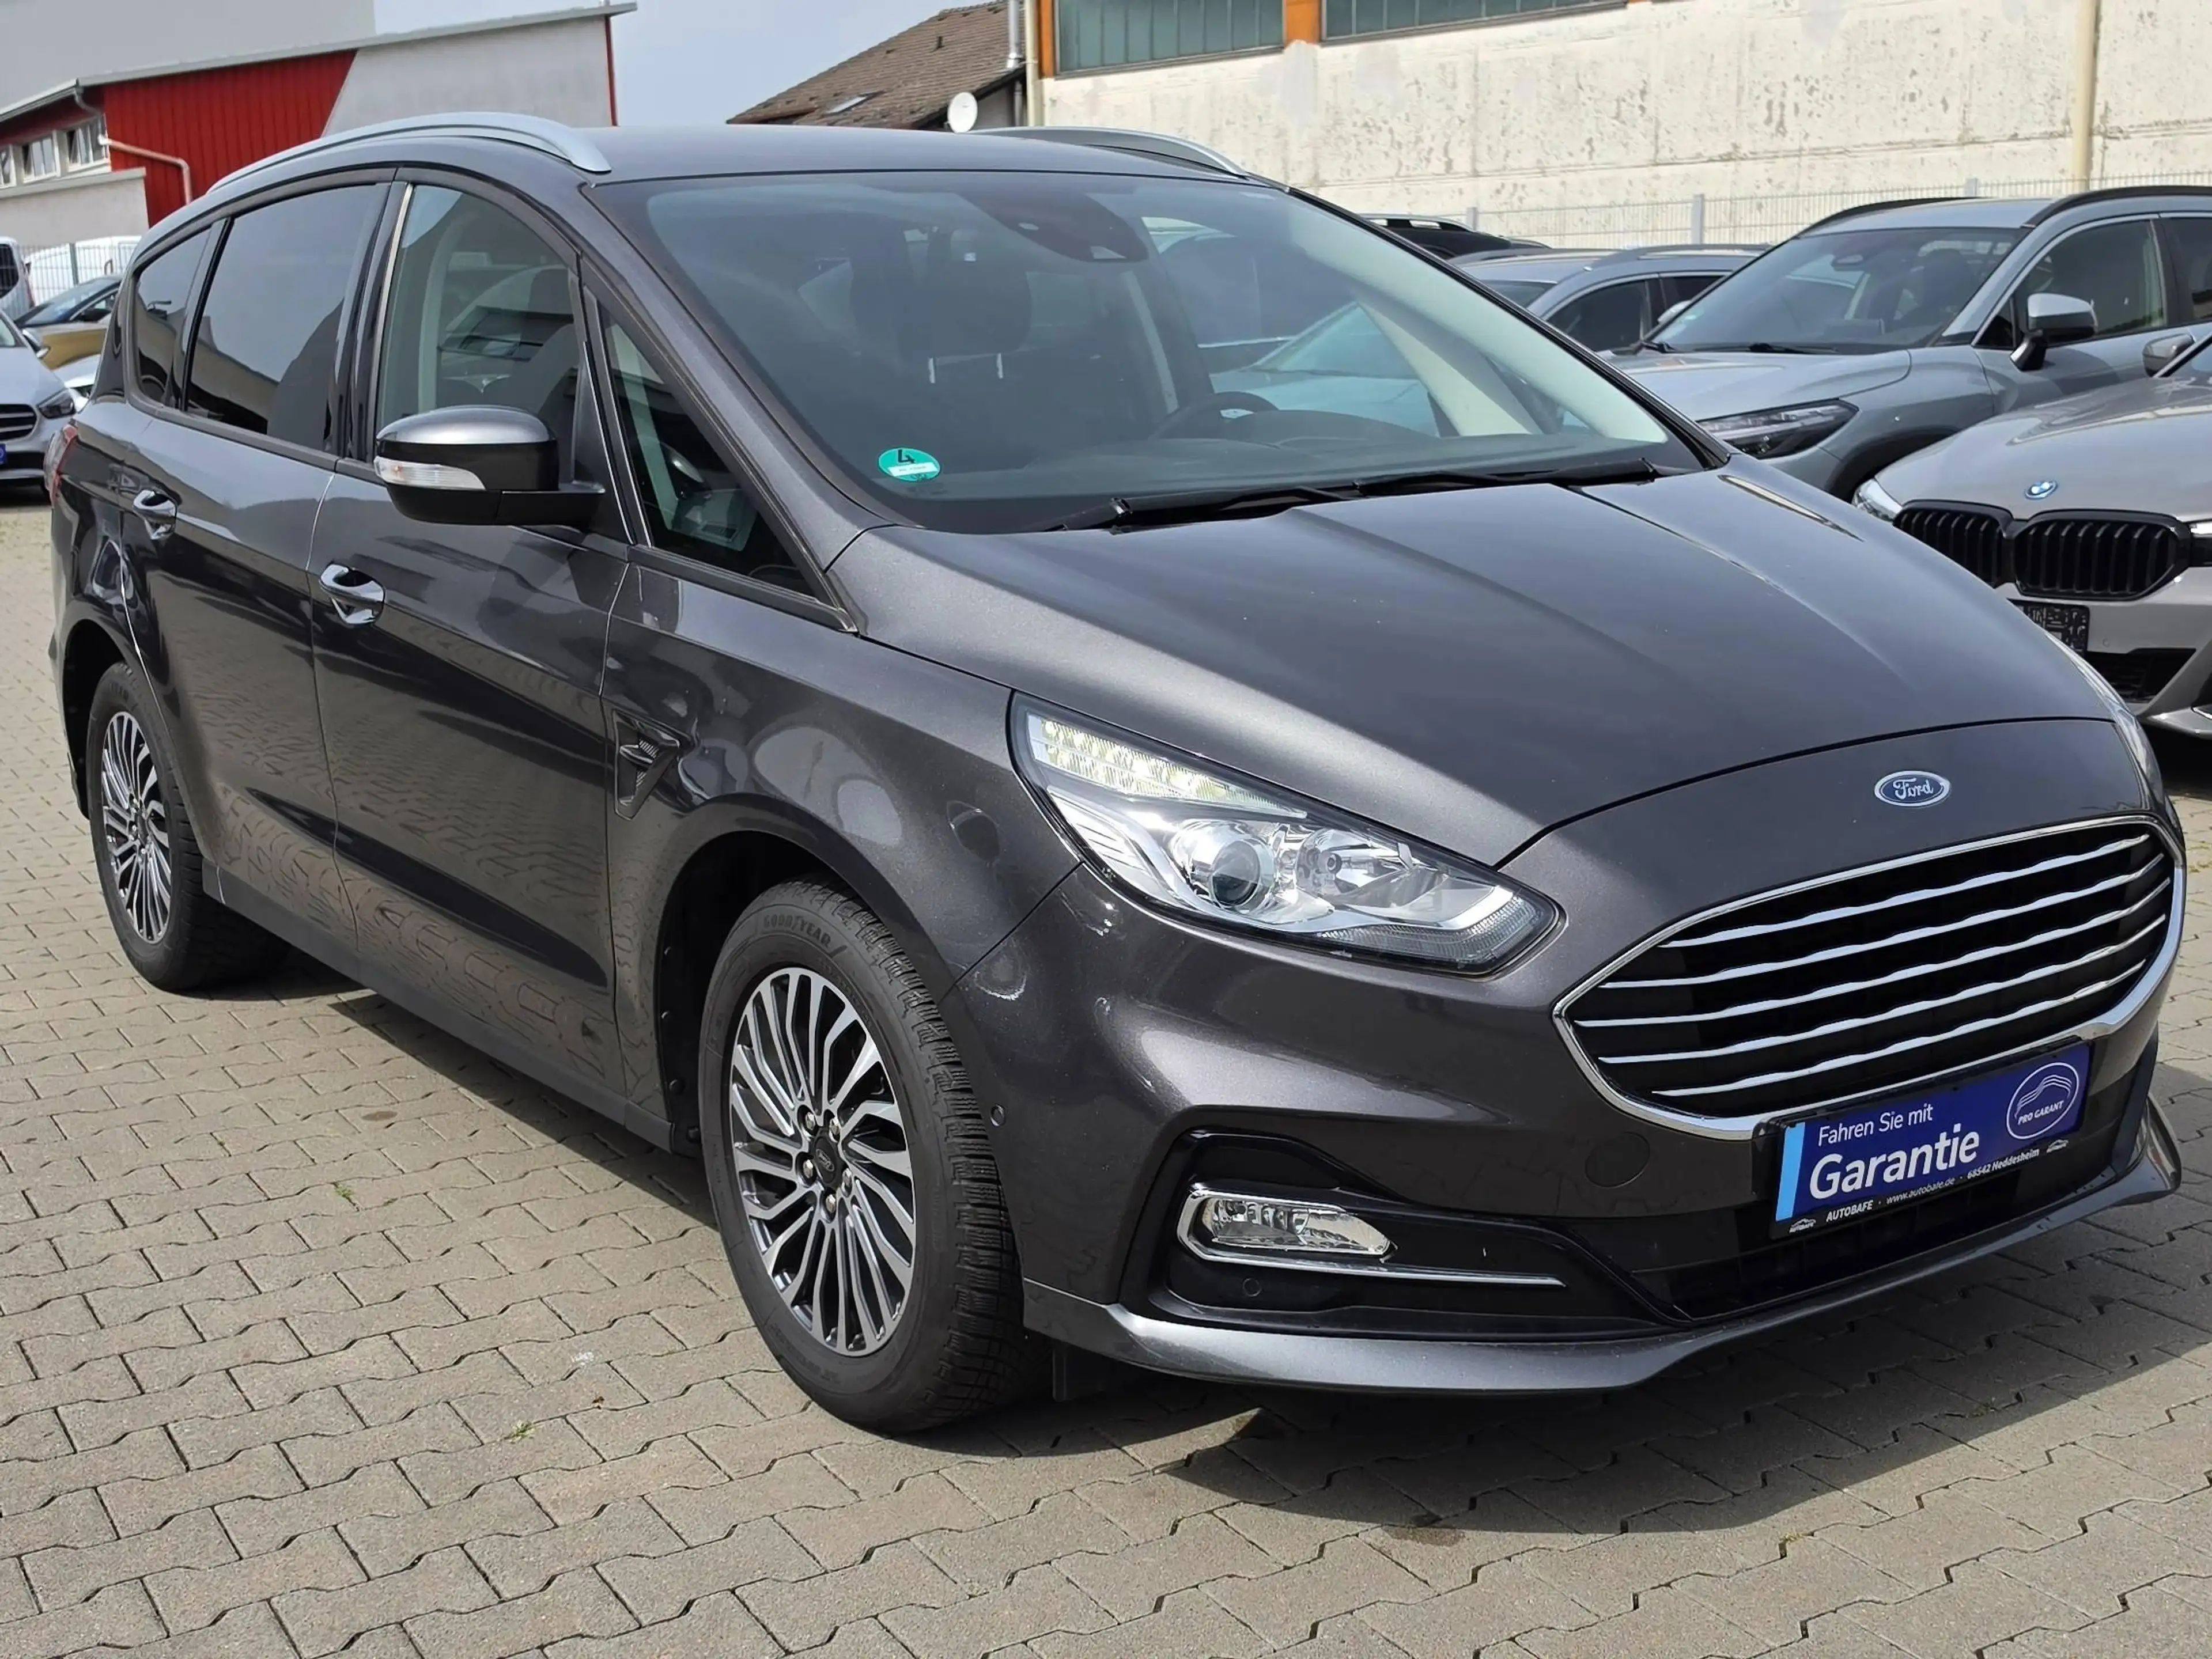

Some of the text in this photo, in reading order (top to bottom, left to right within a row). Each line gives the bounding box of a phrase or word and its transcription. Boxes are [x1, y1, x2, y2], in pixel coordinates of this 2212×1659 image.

[898, 449, 915, 463] 4
[1893, 778, 1933, 800] Ford
[763, 914, 831, 948] GOODYEAR
[1818, 1103, 1934, 1147] Fahren Sie mit
[2018, 1100, 2064, 1125] PRO GARANT
[1809, 1123, 1980, 1199] Garantie
[1825, 1149, 2040, 1222] AUTOBAFE www.autobafe.de 68542 Heddesheim
